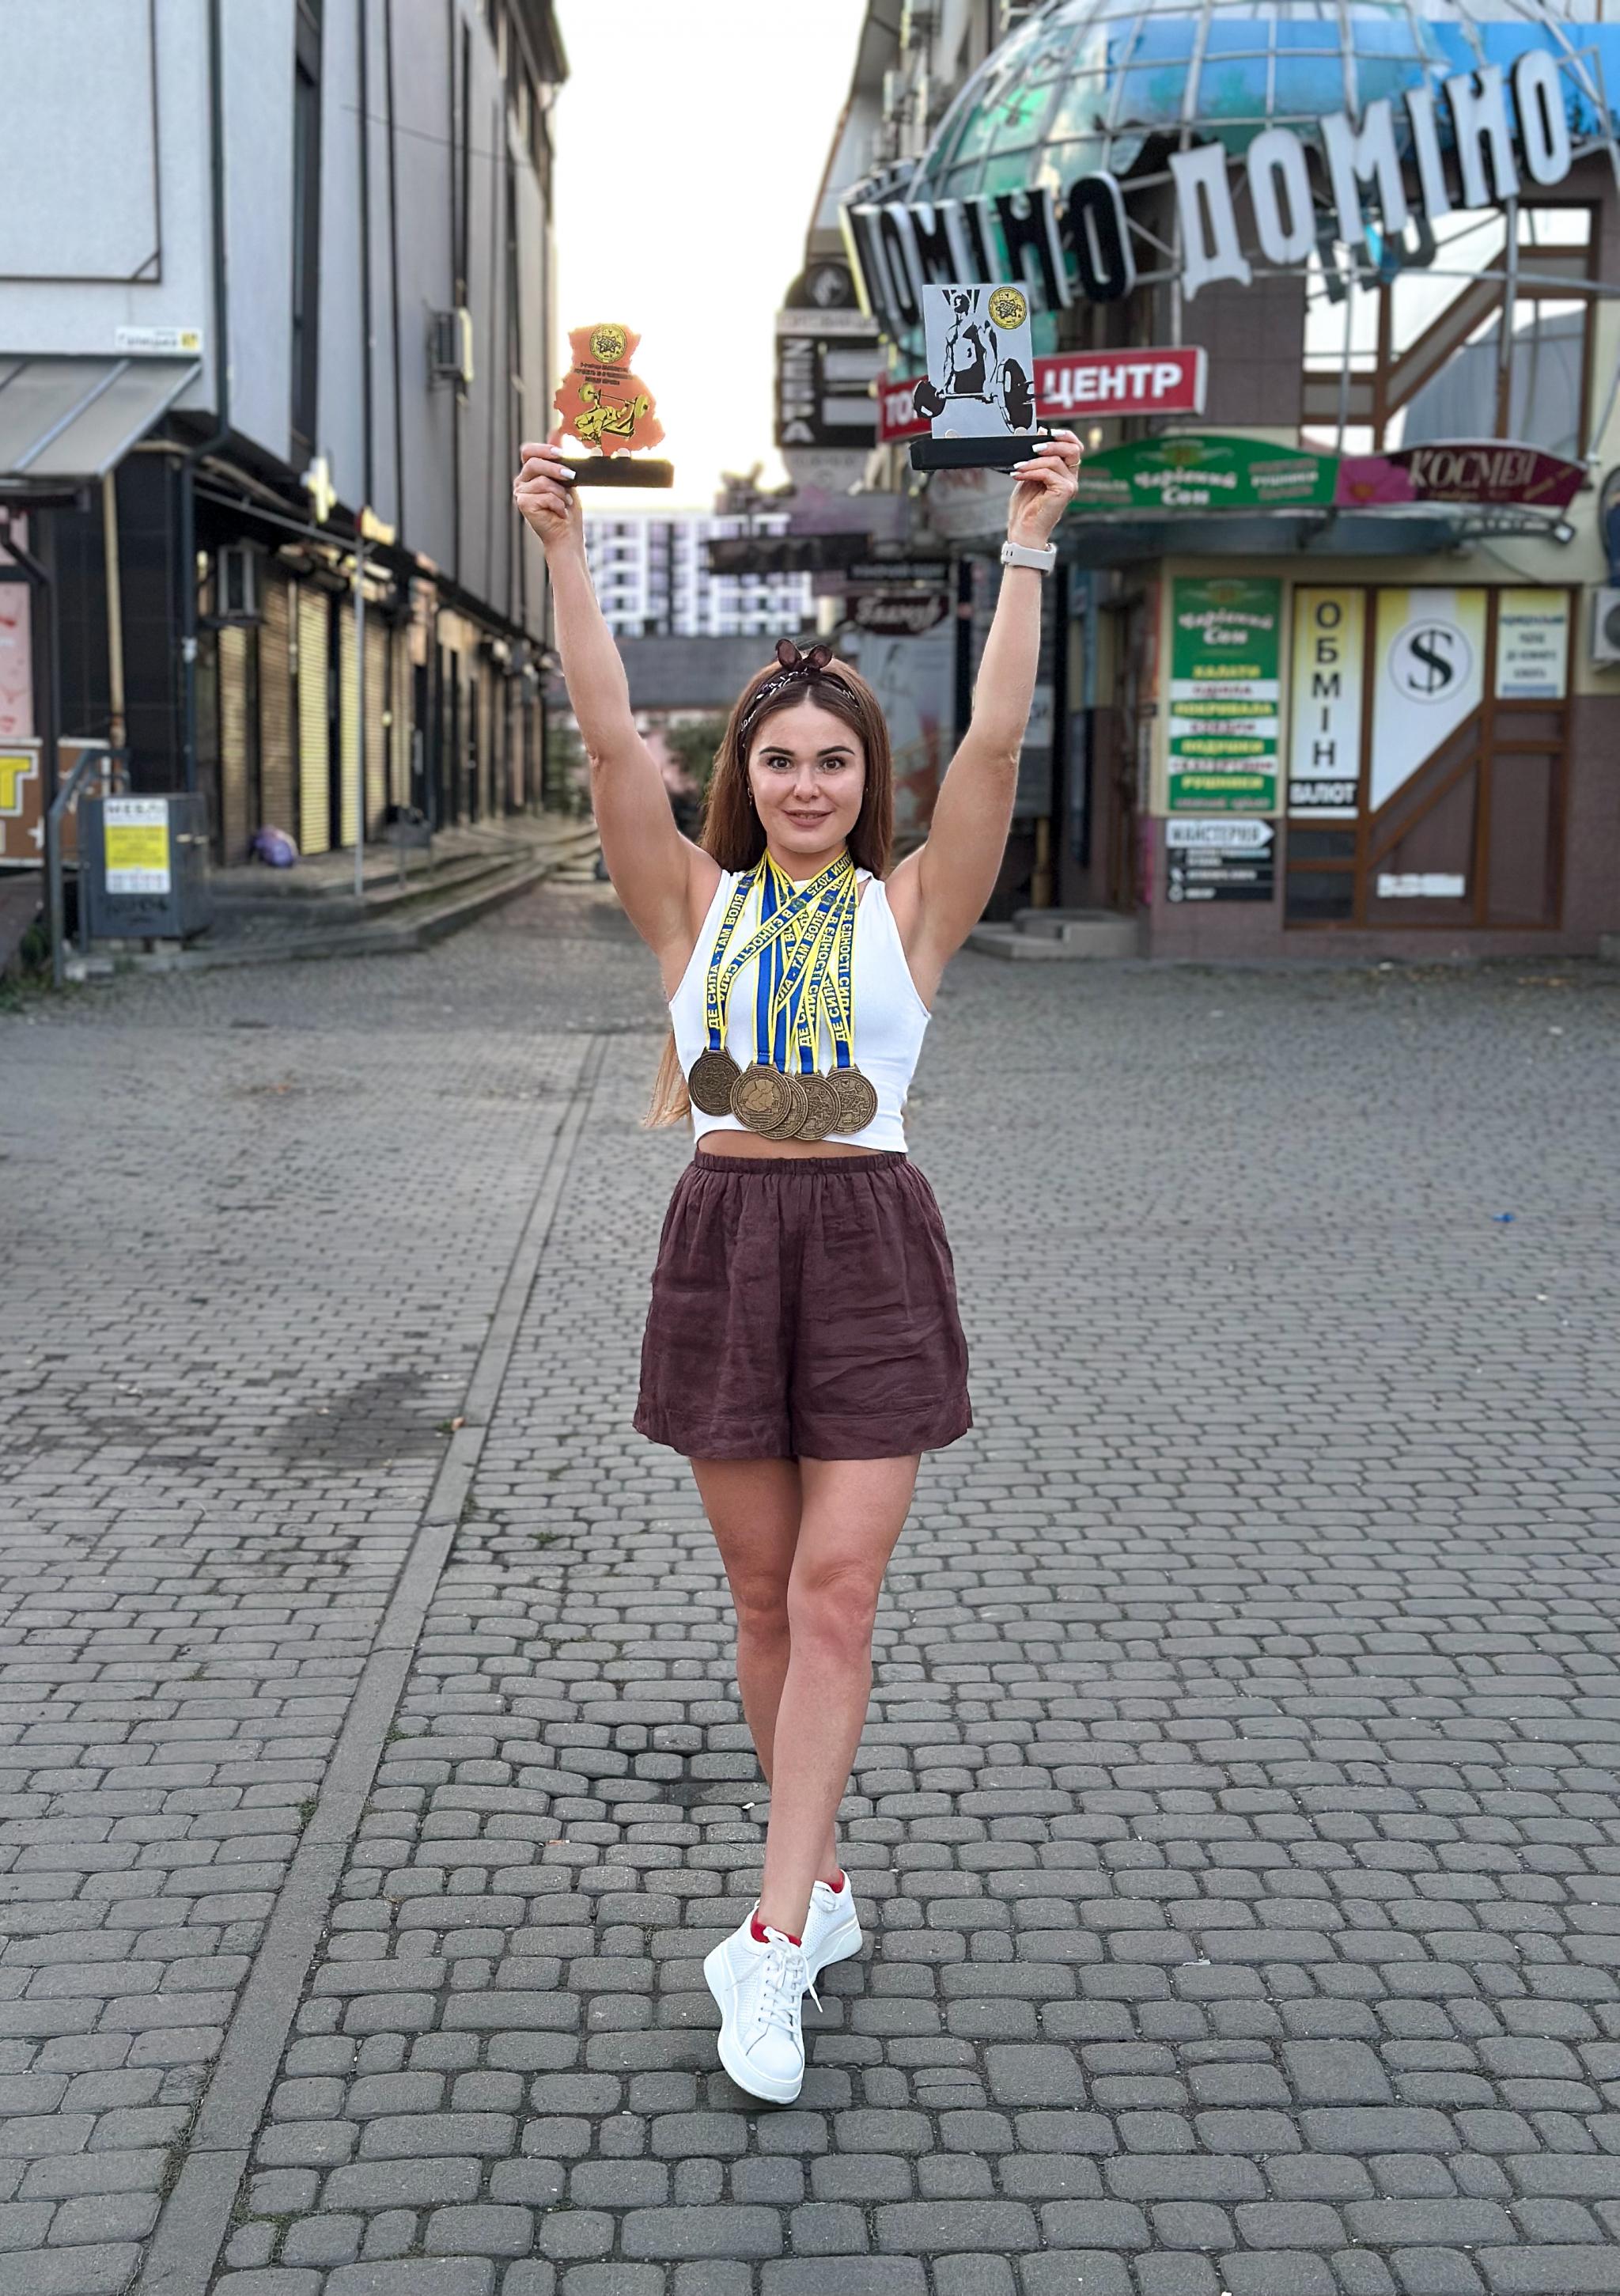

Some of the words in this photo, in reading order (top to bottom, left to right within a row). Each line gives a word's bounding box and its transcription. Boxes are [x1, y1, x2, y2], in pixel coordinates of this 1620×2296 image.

[1168, 49, 1573, 301] ДОМІНО
[1043, 363, 1183, 408] ЦЕНТР
[1312, 601, 1342, 767] ОБМІН
[1289, 782, 1357, 804] ВАЛЮТ
[807, 873, 834, 896] 2025
[725, 893, 745, 927] ВОЛЯ
[714, 928, 731, 957] ТАМ
[736, 918, 785, 964] ЄДНОСТІ
[791, 942, 811, 969] ТАМ
[804, 910, 827, 942] ВОЛЯ
[812, 926, 835, 980] ЄДНОСТІ
[838, 923, 853, 973] ЄДНОСТІ
[706, 963, 721, 1003] СИЛА
[707, 1007, 720, 1029] ДЕ
[798, 1027, 812, 1047] ДЕ
[832, 1021, 848, 1042] ДЕ
